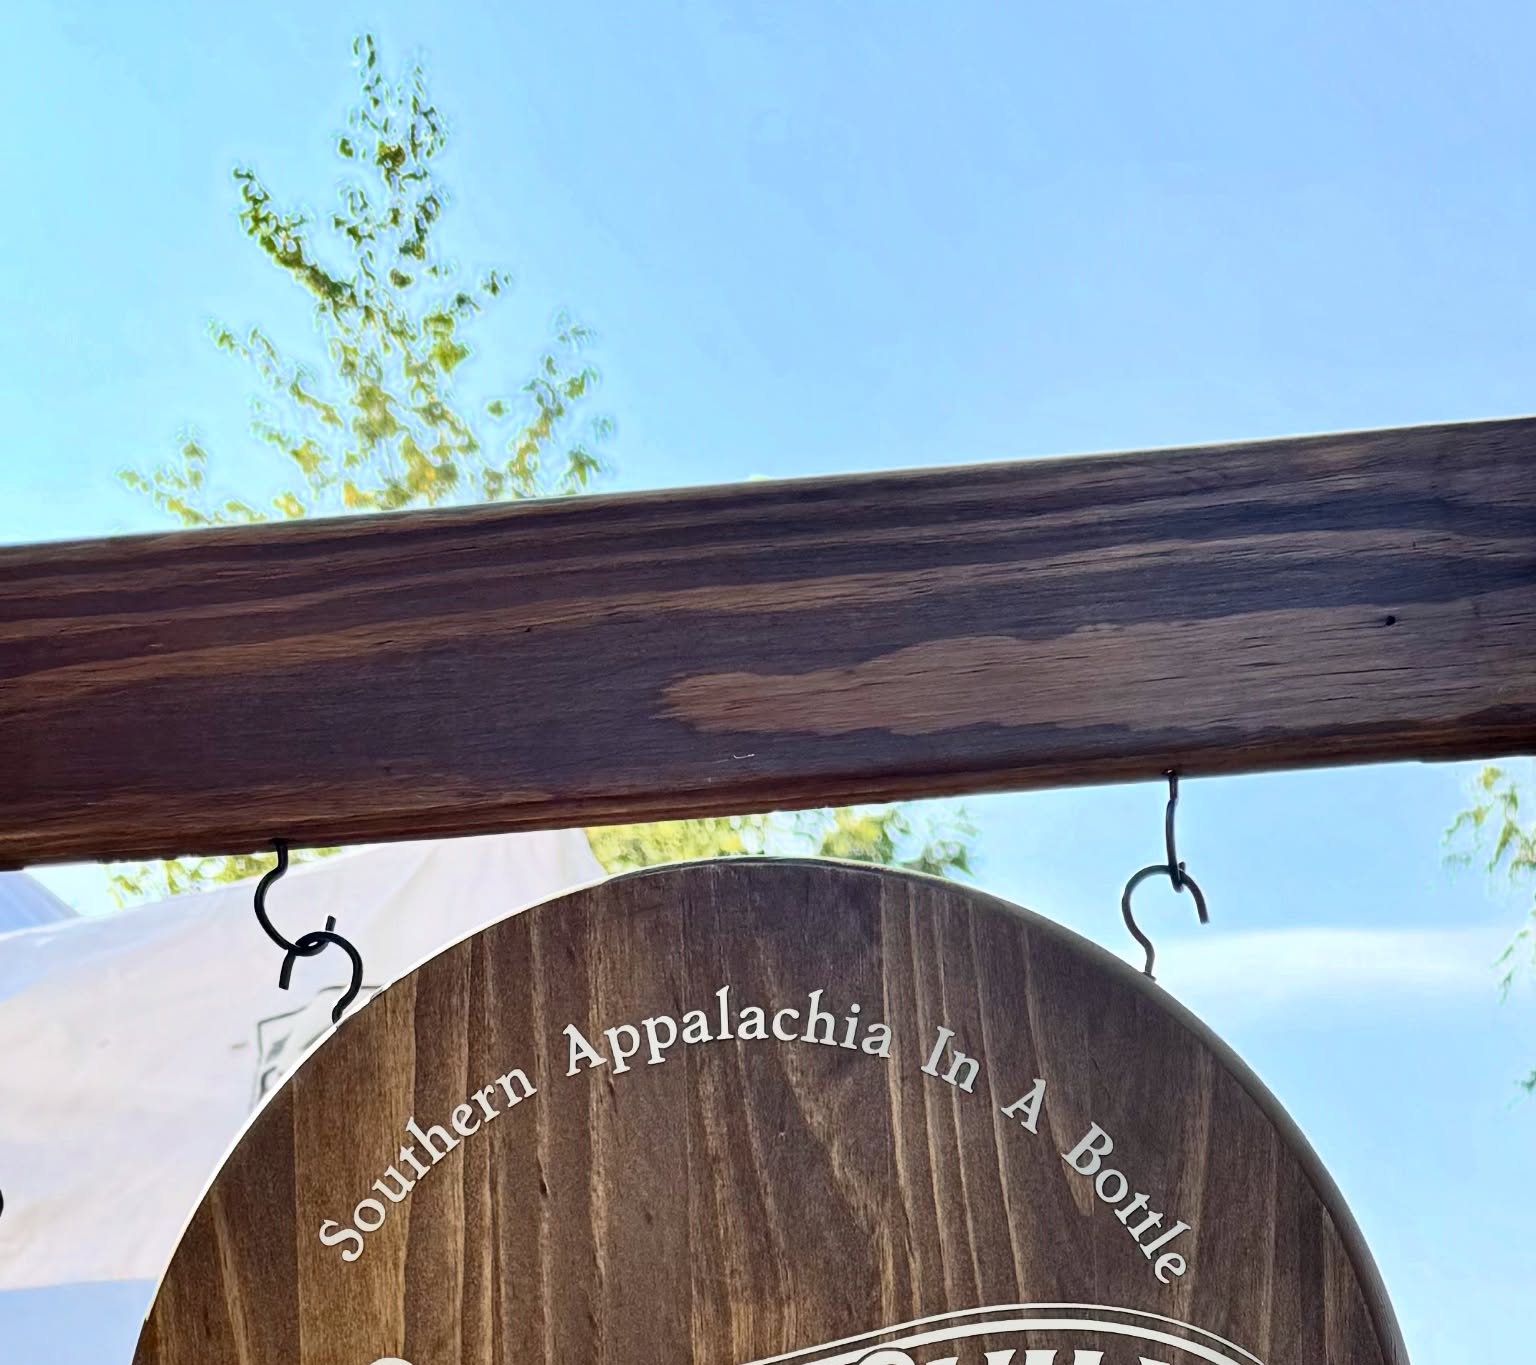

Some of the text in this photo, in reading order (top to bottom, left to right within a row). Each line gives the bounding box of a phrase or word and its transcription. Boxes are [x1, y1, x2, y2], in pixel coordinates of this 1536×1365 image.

[317, 984, 1192, 1284] Southern Appalachia In A Bottle
